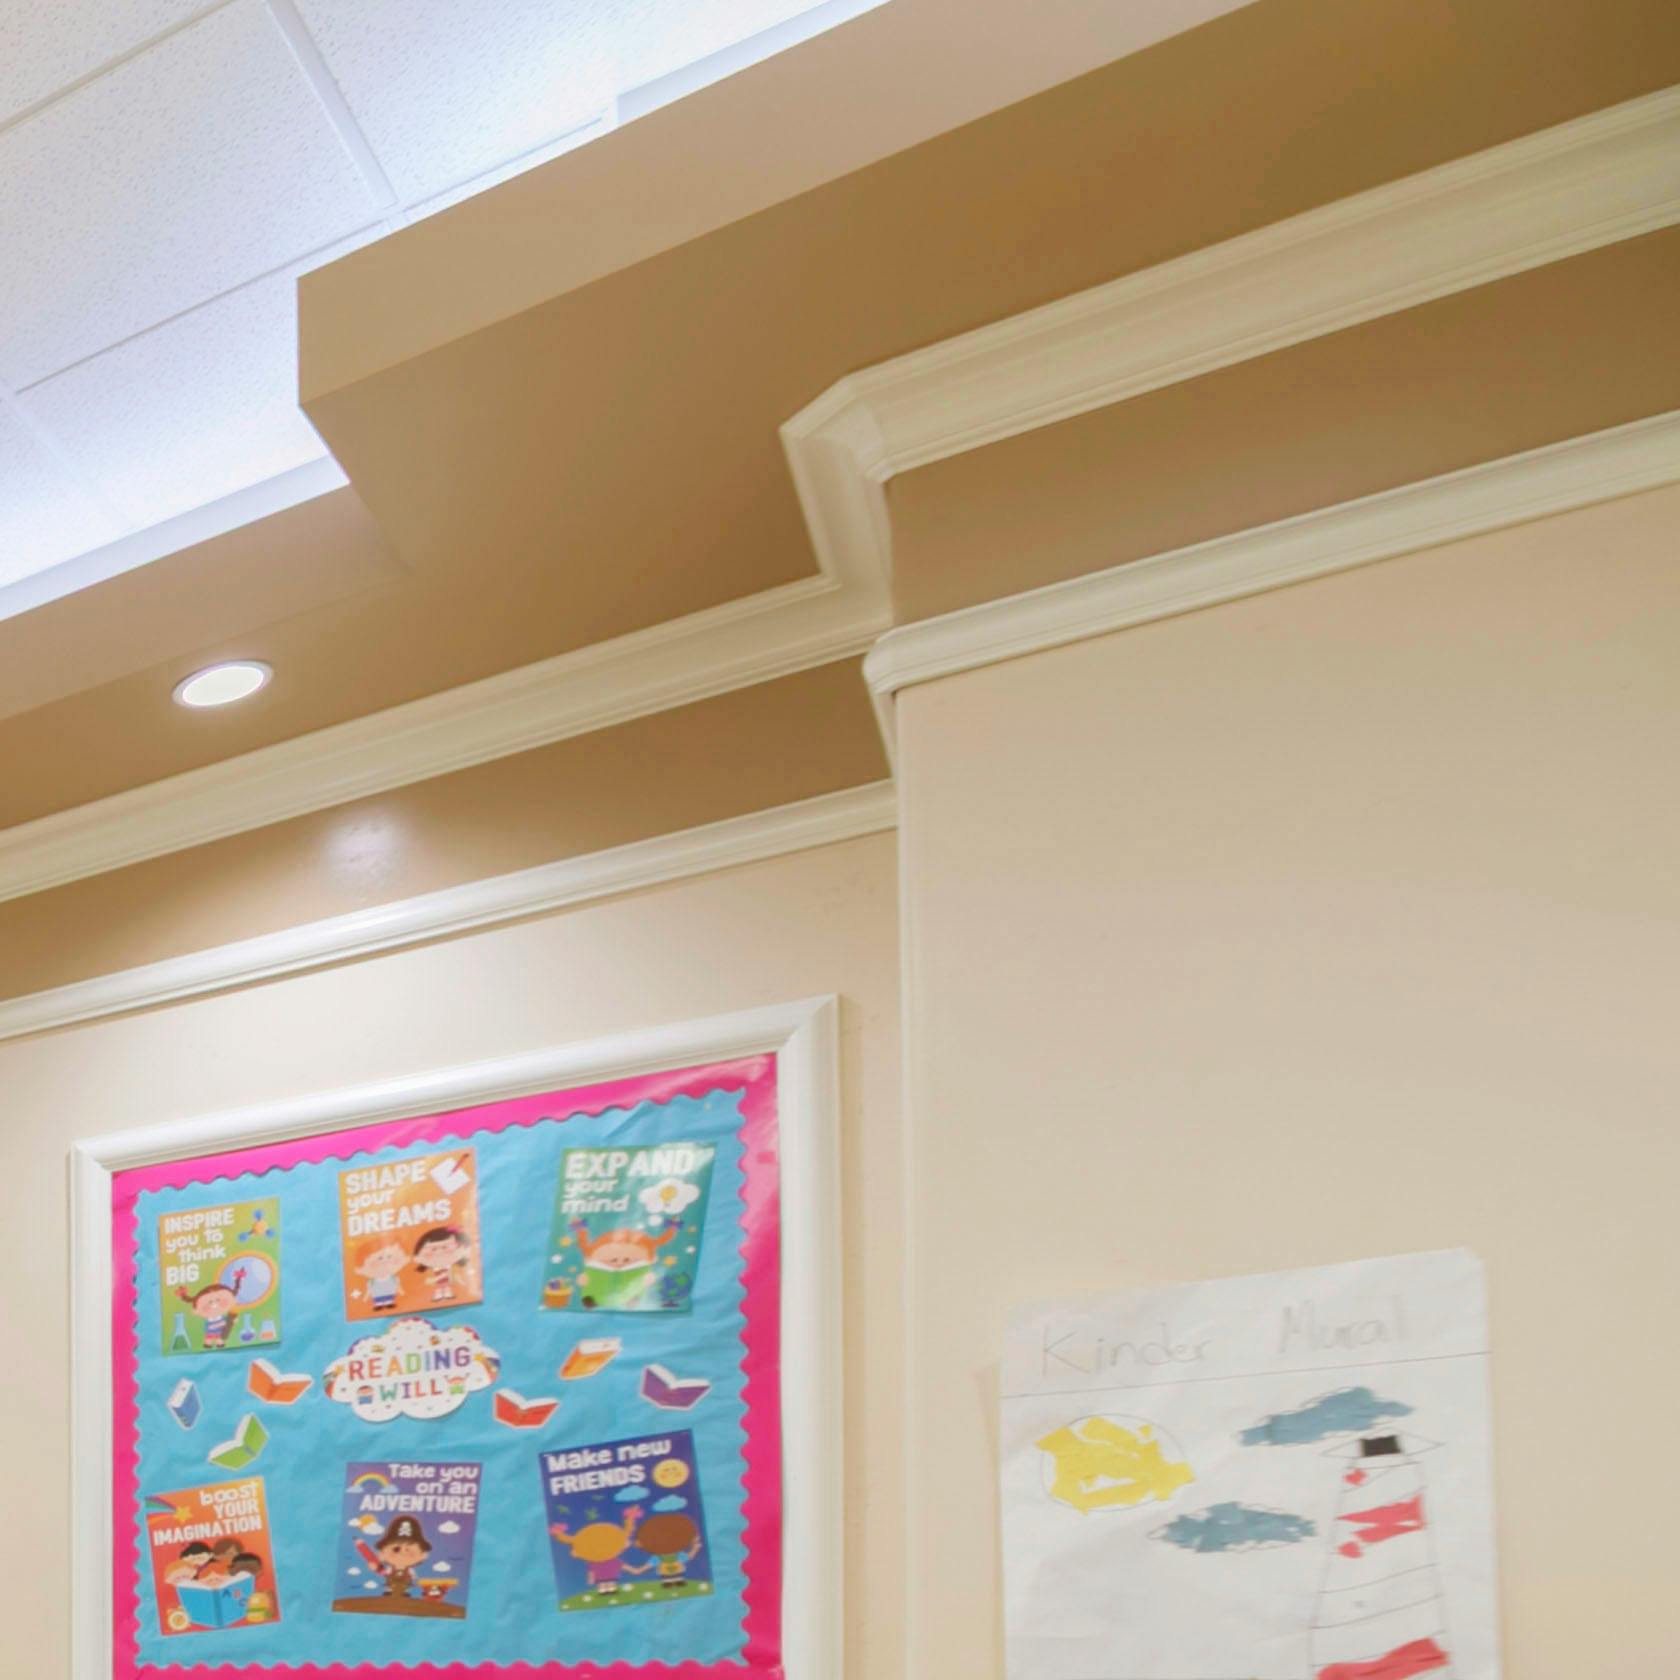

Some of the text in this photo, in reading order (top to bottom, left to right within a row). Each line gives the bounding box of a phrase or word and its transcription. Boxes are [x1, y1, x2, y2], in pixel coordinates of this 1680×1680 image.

[564, 1148, 696, 1179] EXPAND
[345, 1160, 427, 1195] SHAPE
[564, 1178, 618, 1199] your
[346, 1189, 396, 1215] your
[561, 1194, 630, 1214] mind
[164, 1207, 235, 1235] INSPIRE
[348, 1199, 452, 1238] DREAMS
[166, 1233, 199, 1254] you
[165, 1263, 200, 1287] BIG
[1041, 1321, 1213, 1378] Kinder
[348, 1346, 471, 1382] READING
[379, 1379, 444, 1402] WILL
[547, 1439, 673, 1473] Make new
[389, 1463, 479, 1483] Take you
[549, 1464, 646, 1496] FRIENDS
[199, 1482, 258, 1506] boost
[415, 1480, 478, 1495] on an
[214, 1498, 259, 1519] YOUR
[359, 1494, 476, 1513] ADVENTURE
[153, 1515, 263, 1547] IMAGINATION
